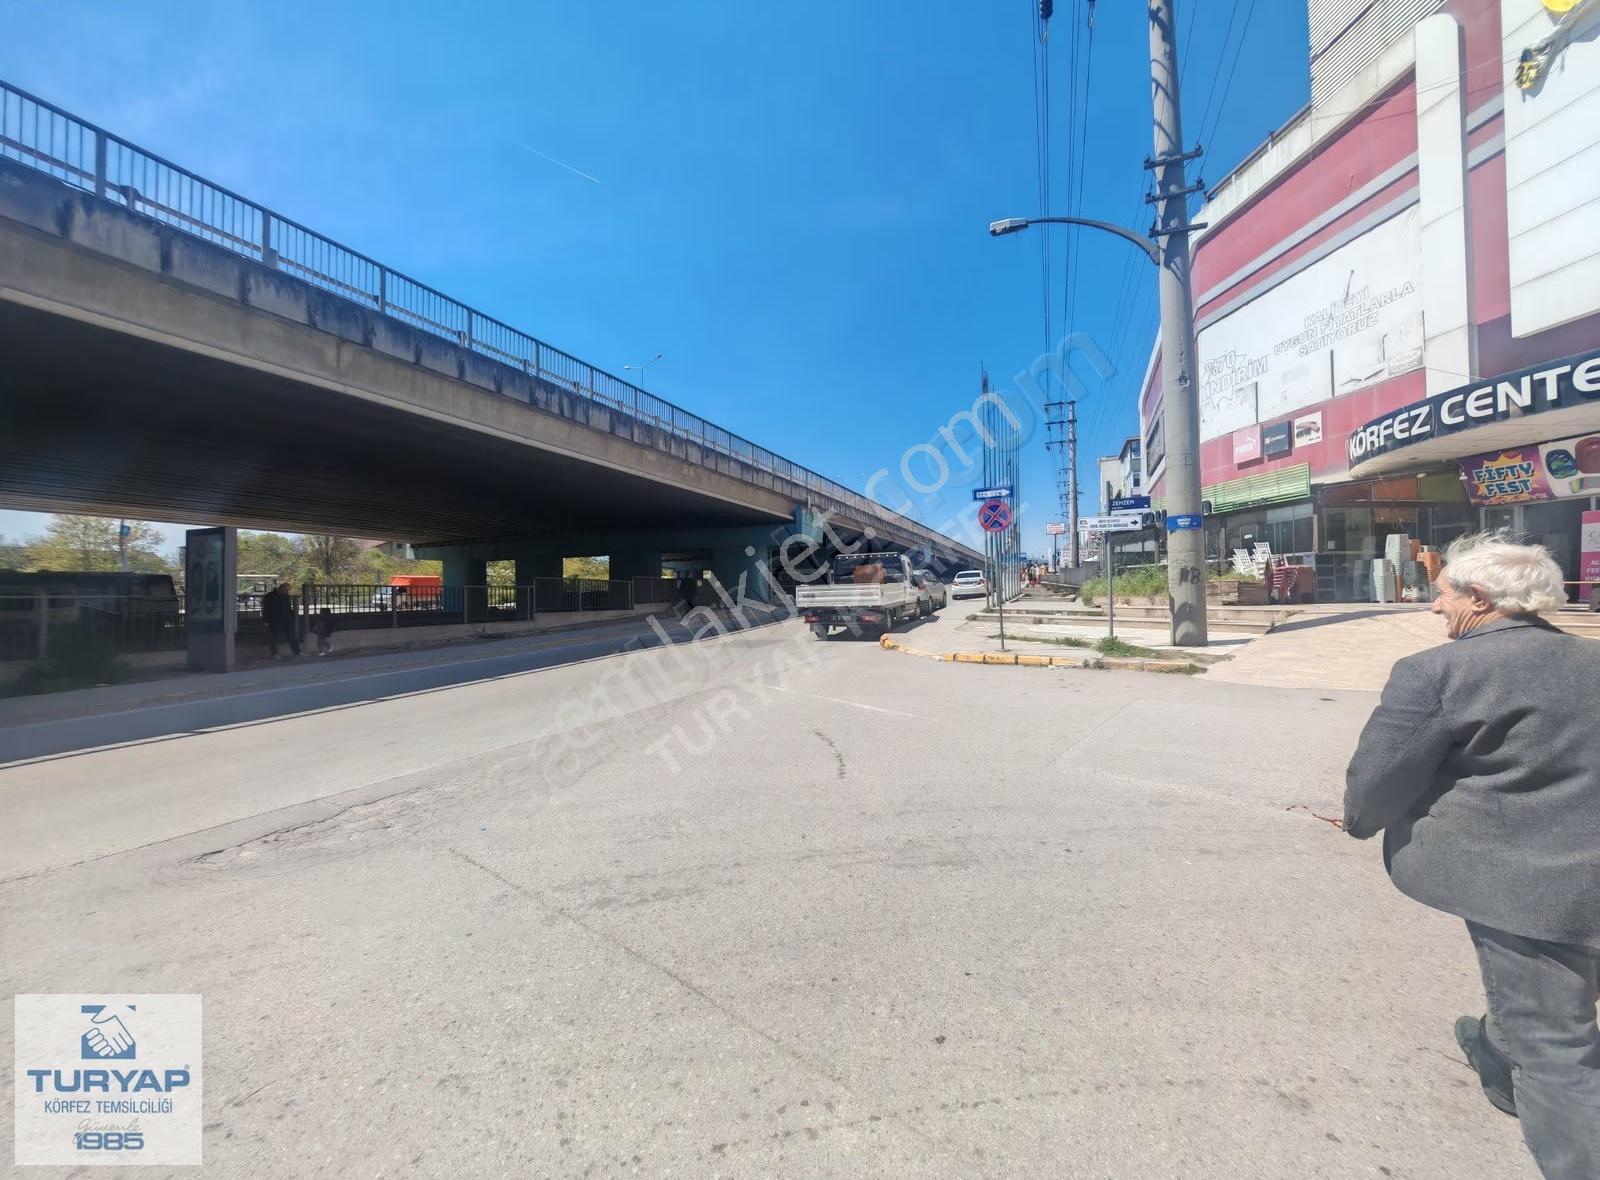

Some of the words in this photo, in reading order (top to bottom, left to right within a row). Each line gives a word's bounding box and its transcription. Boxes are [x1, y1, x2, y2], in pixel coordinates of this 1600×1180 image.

[1273, 327, 1319, 356] UYGUN
[1320, 280, 1415, 335] FİYATLARLA
[1304, 284, 1370, 328] KALİTEYİ
[1299, 311, 1379, 357] SATIYORUZ
[1349, 404, 1432, 460] KÖRFEZ
[1472, 461, 1535, 483] FİFTY
[1485, 478, 1533, 497] FEST
